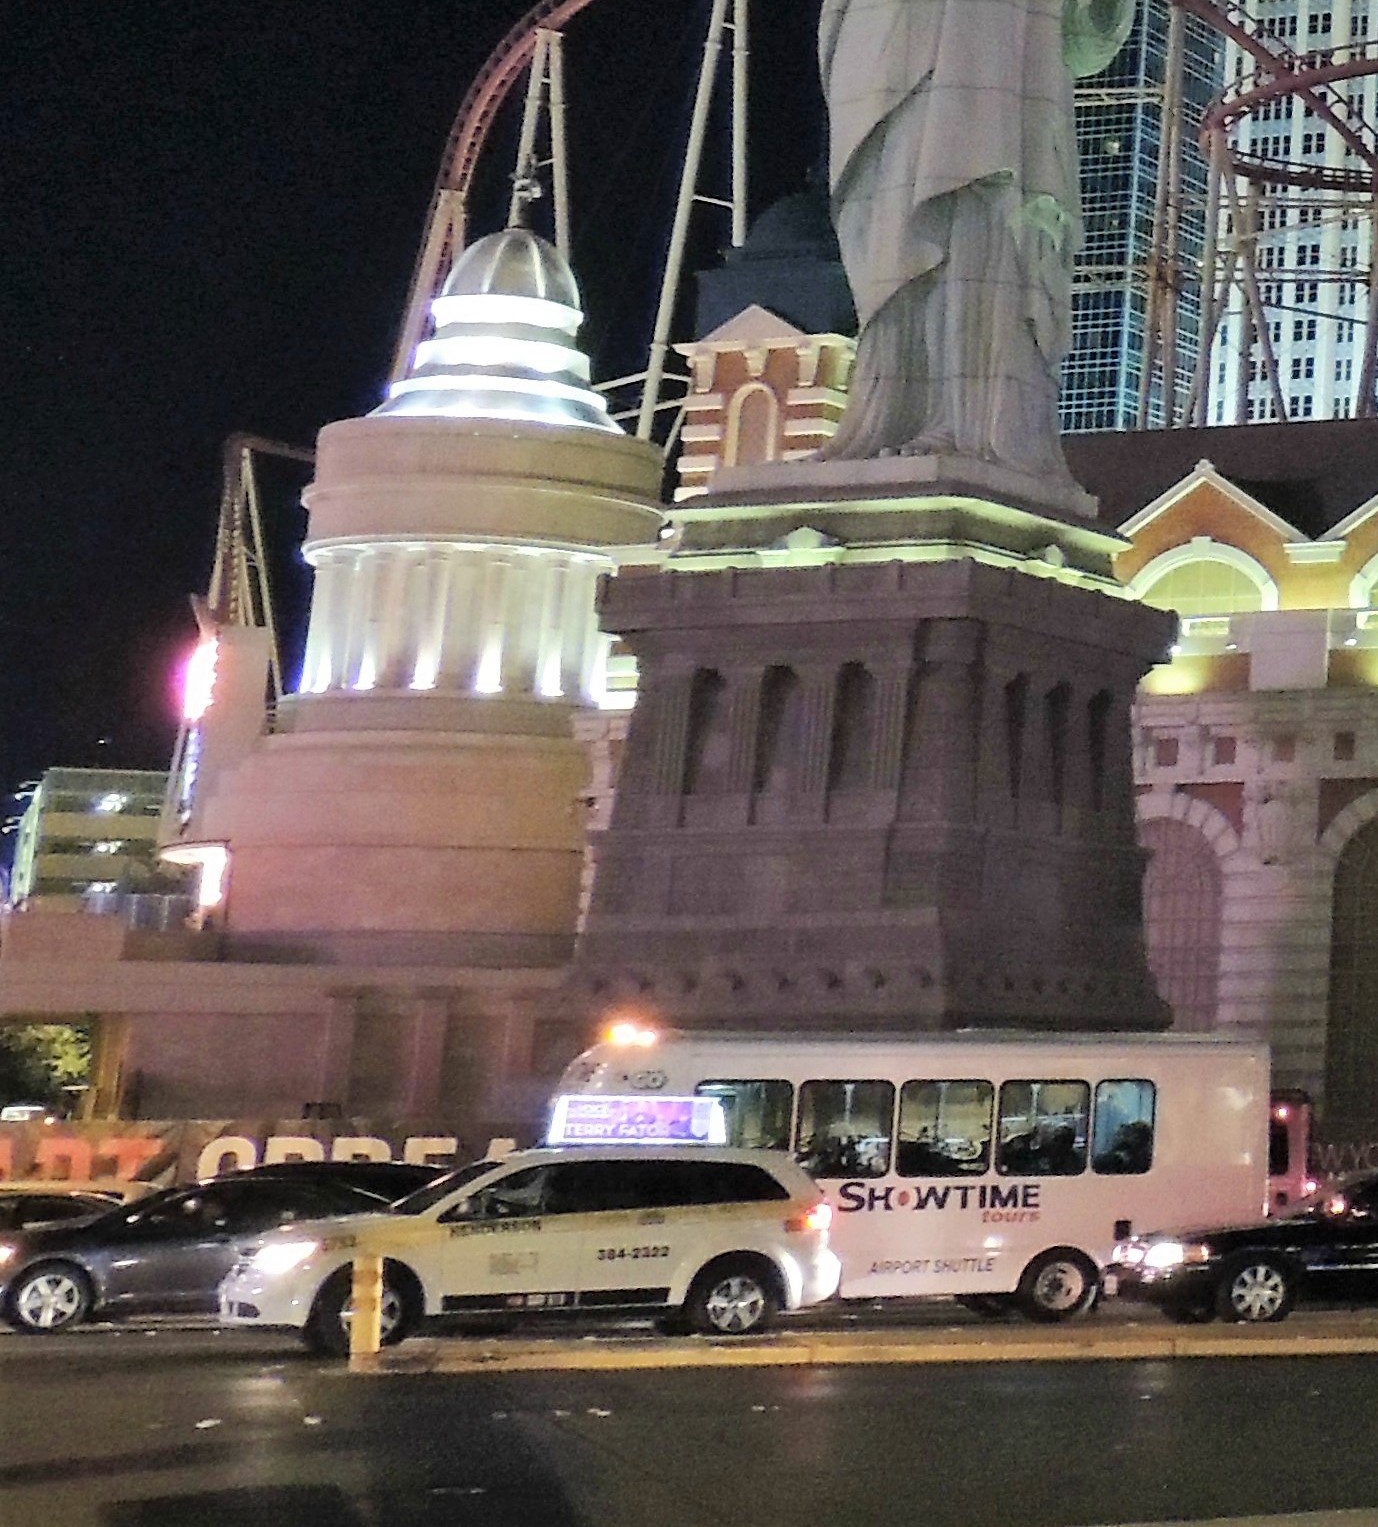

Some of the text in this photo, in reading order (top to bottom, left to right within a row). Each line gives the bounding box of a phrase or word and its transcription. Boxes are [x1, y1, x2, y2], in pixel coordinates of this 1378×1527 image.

[565, 1124, 613, 1137] TERRY
[837, 1181, 1040, 1212] SHOWTIME
[982, 1210, 1041, 1223] tours
[871, 1257, 996, 1275] AIRPORT SHUTTLE
